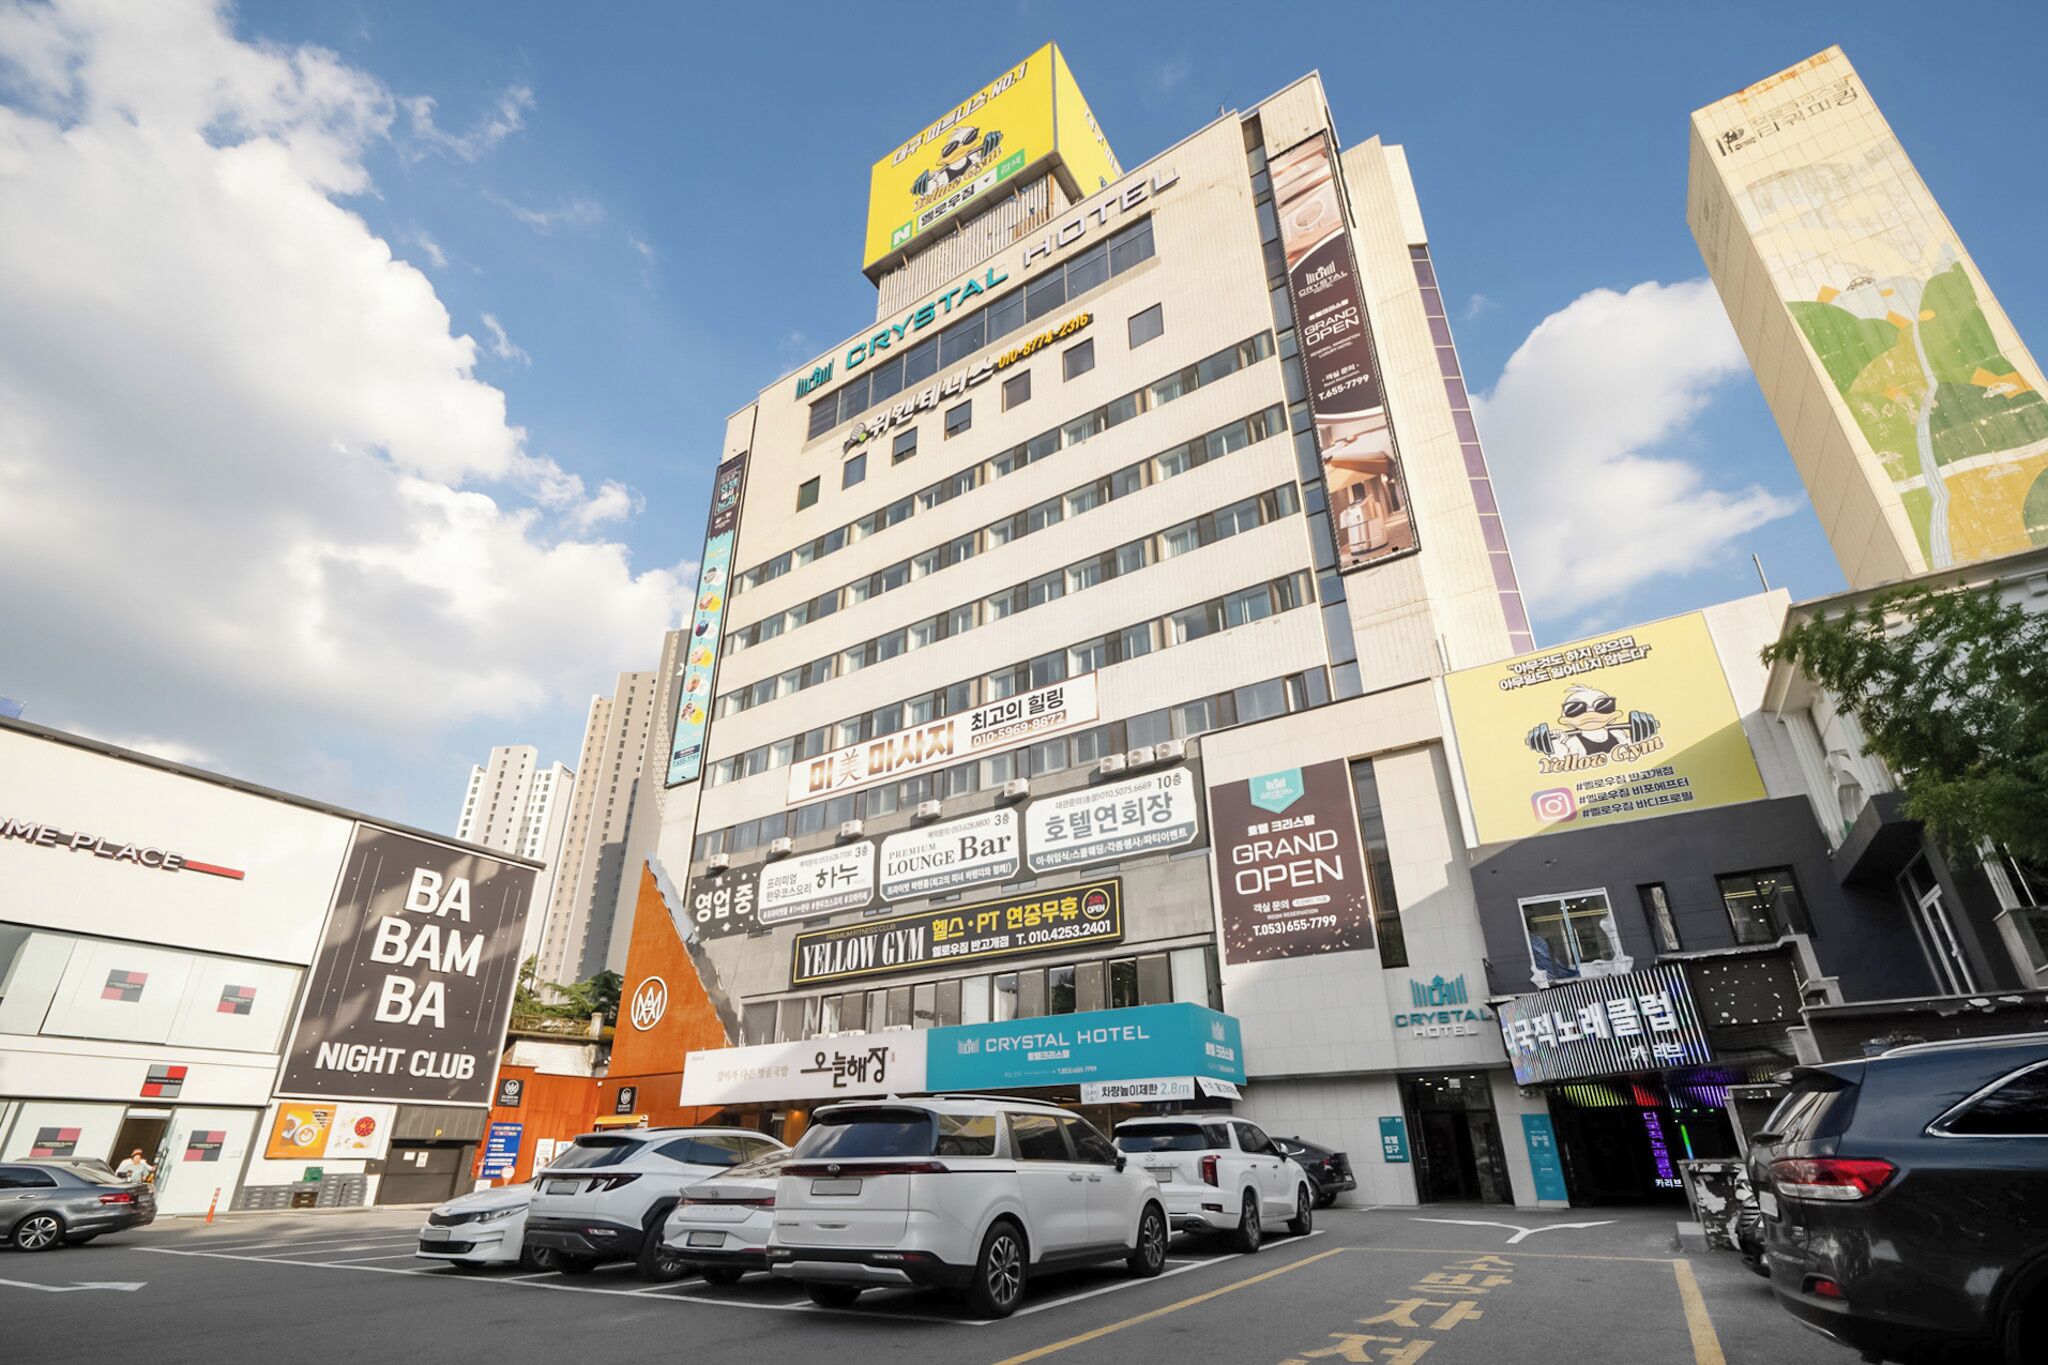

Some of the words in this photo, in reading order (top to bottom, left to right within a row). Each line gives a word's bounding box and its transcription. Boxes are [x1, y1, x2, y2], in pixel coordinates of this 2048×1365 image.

[846, 267, 1009, 369] CRYSTAL
[1024, 166, 1182, 268] HOTEL
[1304, 306, 1358, 336] GRAND
[1306, 315, 1360, 346] OPEN
[1565, 646, 1592, 663] 하지
[1593, 635, 1635, 655] 않으면
[1499, 670, 1550, 691] 아무일도
[1551, 658, 1602, 680] 일어나지
[971, 699, 1022, 731] 최고의
[1028, 687, 1063, 715] 힐링
[867, 720, 955, 777] 마사지
[1539, 752, 1608, 774] Yellow
[1611, 736, 1664, 762] Gym
[1156, 772, 1182, 790] 10층
[1576, 775, 1627, 792] #옐로우짐
[1628, 765, 1675, 781] 반고개점
[1579, 788, 1630, 804] #옐로우짐
[1582, 802, 1634, 818] #옐로우짐
[1636, 791, 1694, 809] 바디프로필
[1044, 791, 1173, 843] 호텔연회장
[1271, 814, 1316, 833] 크리스탈
[0, 815, 60, 846] ME
[70, 831, 184, 870] PLACE
[887, 849, 955, 877] LOUNGE
[958, 834, 1012, 862] Bar
[889, 842, 936, 860] PREMIUM
[1232, 829, 1339, 865] GRAND
[767, 873, 798, 890] 프리미엄
[815, 863, 859, 889] 하누
[1235, 855, 1344, 895] OPEN
[405, 867, 471, 922] BA
[694, 886, 732, 923] 영업
[733, 882, 755, 915] 중
[1087, 903, 1106, 914] OPEN
[1006, 896, 1079, 930] 연중무휴
[1252, 914, 1337, 937] T.053)655-7799
[370, 915, 485, 977] BAM
[802, 934, 878, 978] YELLOW
[881, 926, 926, 966] GYM
[971, 935, 1010, 953] 반고개점
[1028, 919, 1111, 945] 010.4253.2401
[374, 974, 446, 1029] BA
[1394, 1007, 1494, 1028] CRYSTAL
[985, 1031, 1070, 1053] CRYSTAL
[1077, 1025, 1150, 1044] HOTEL
[1413, 1024, 1478, 1039] HOTEL
[314, 1041, 406, 1075] NIGHT
[409, 1049, 477, 1080] CLUB
[1101, 1084, 1158, 1098] 차량높이제한
[1160, 1082, 1190, 1096] 2.8m
[1655, 1178, 1684, 1188] 카리브
